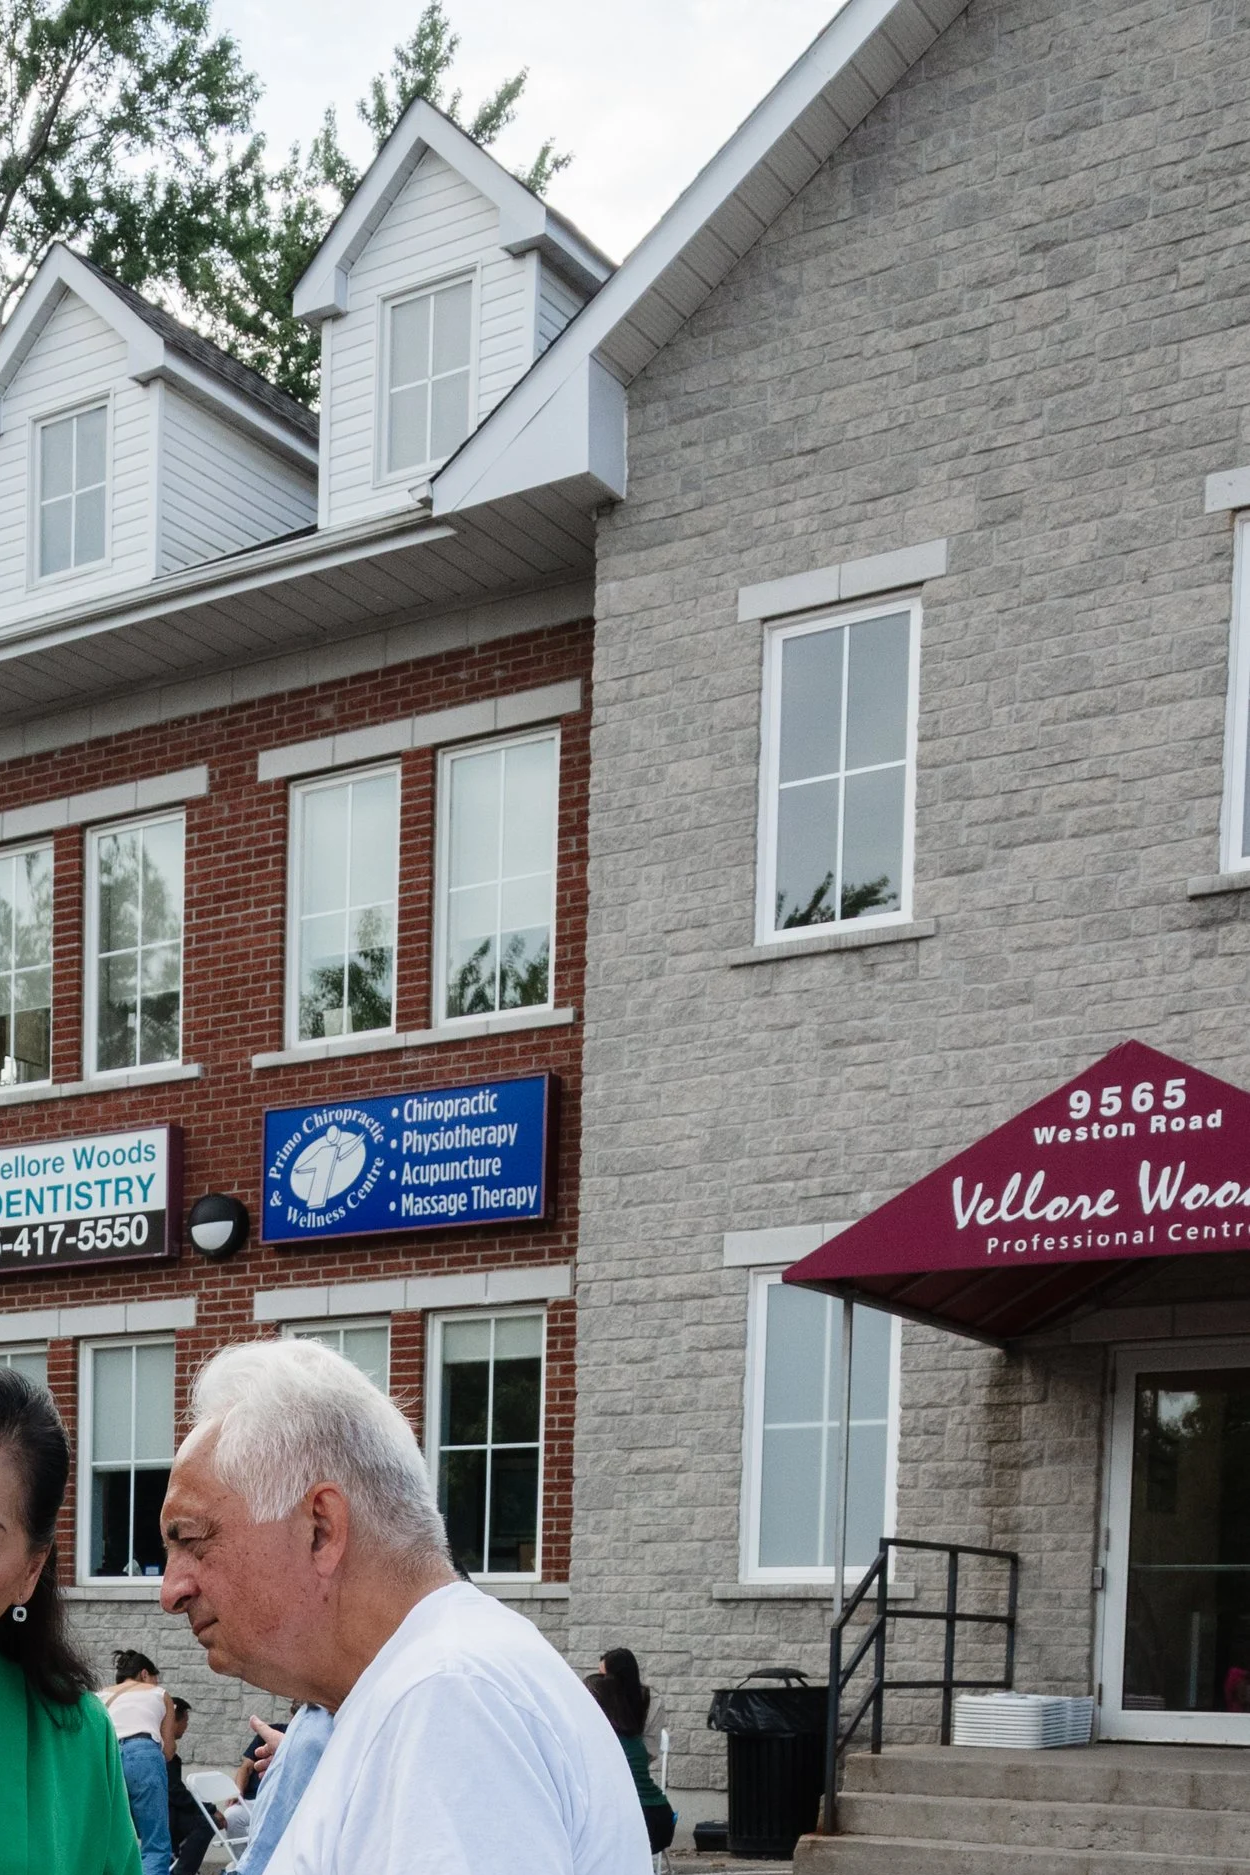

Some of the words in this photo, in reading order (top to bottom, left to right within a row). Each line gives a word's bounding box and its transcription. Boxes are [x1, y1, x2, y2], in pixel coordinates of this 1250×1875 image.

[403, 1089, 498, 1123] Chiropractic
[1069, 1077, 1187, 1120] 9565
[268, 1131, 302, 1181] Primo
[302, 1108, 385, 1145] Chiropractic
[402, 1122, 518, 1157] Physiotherapy
[1034, 1121, 1136, 1146] Weston
[1150, 1109, 1223, 1134] Road
[72, 1139, 156, 1171] Woods
[401, 1156, 502, 1188] Acupuncture
[269, 1190, 283, 1208] &
[286, 1205, 347, 1229] Wellness
[346, 1156, 386, 1209] Centre
[401, 1191, 468, 1218] Massage
[471, 1185, 538, 1213] Therapy
[952, 1169, 1119, 1231] Vellore
[987, 1225, 1155, 1255] Professional
[1168, 1221, 1250, 1242] Centr
